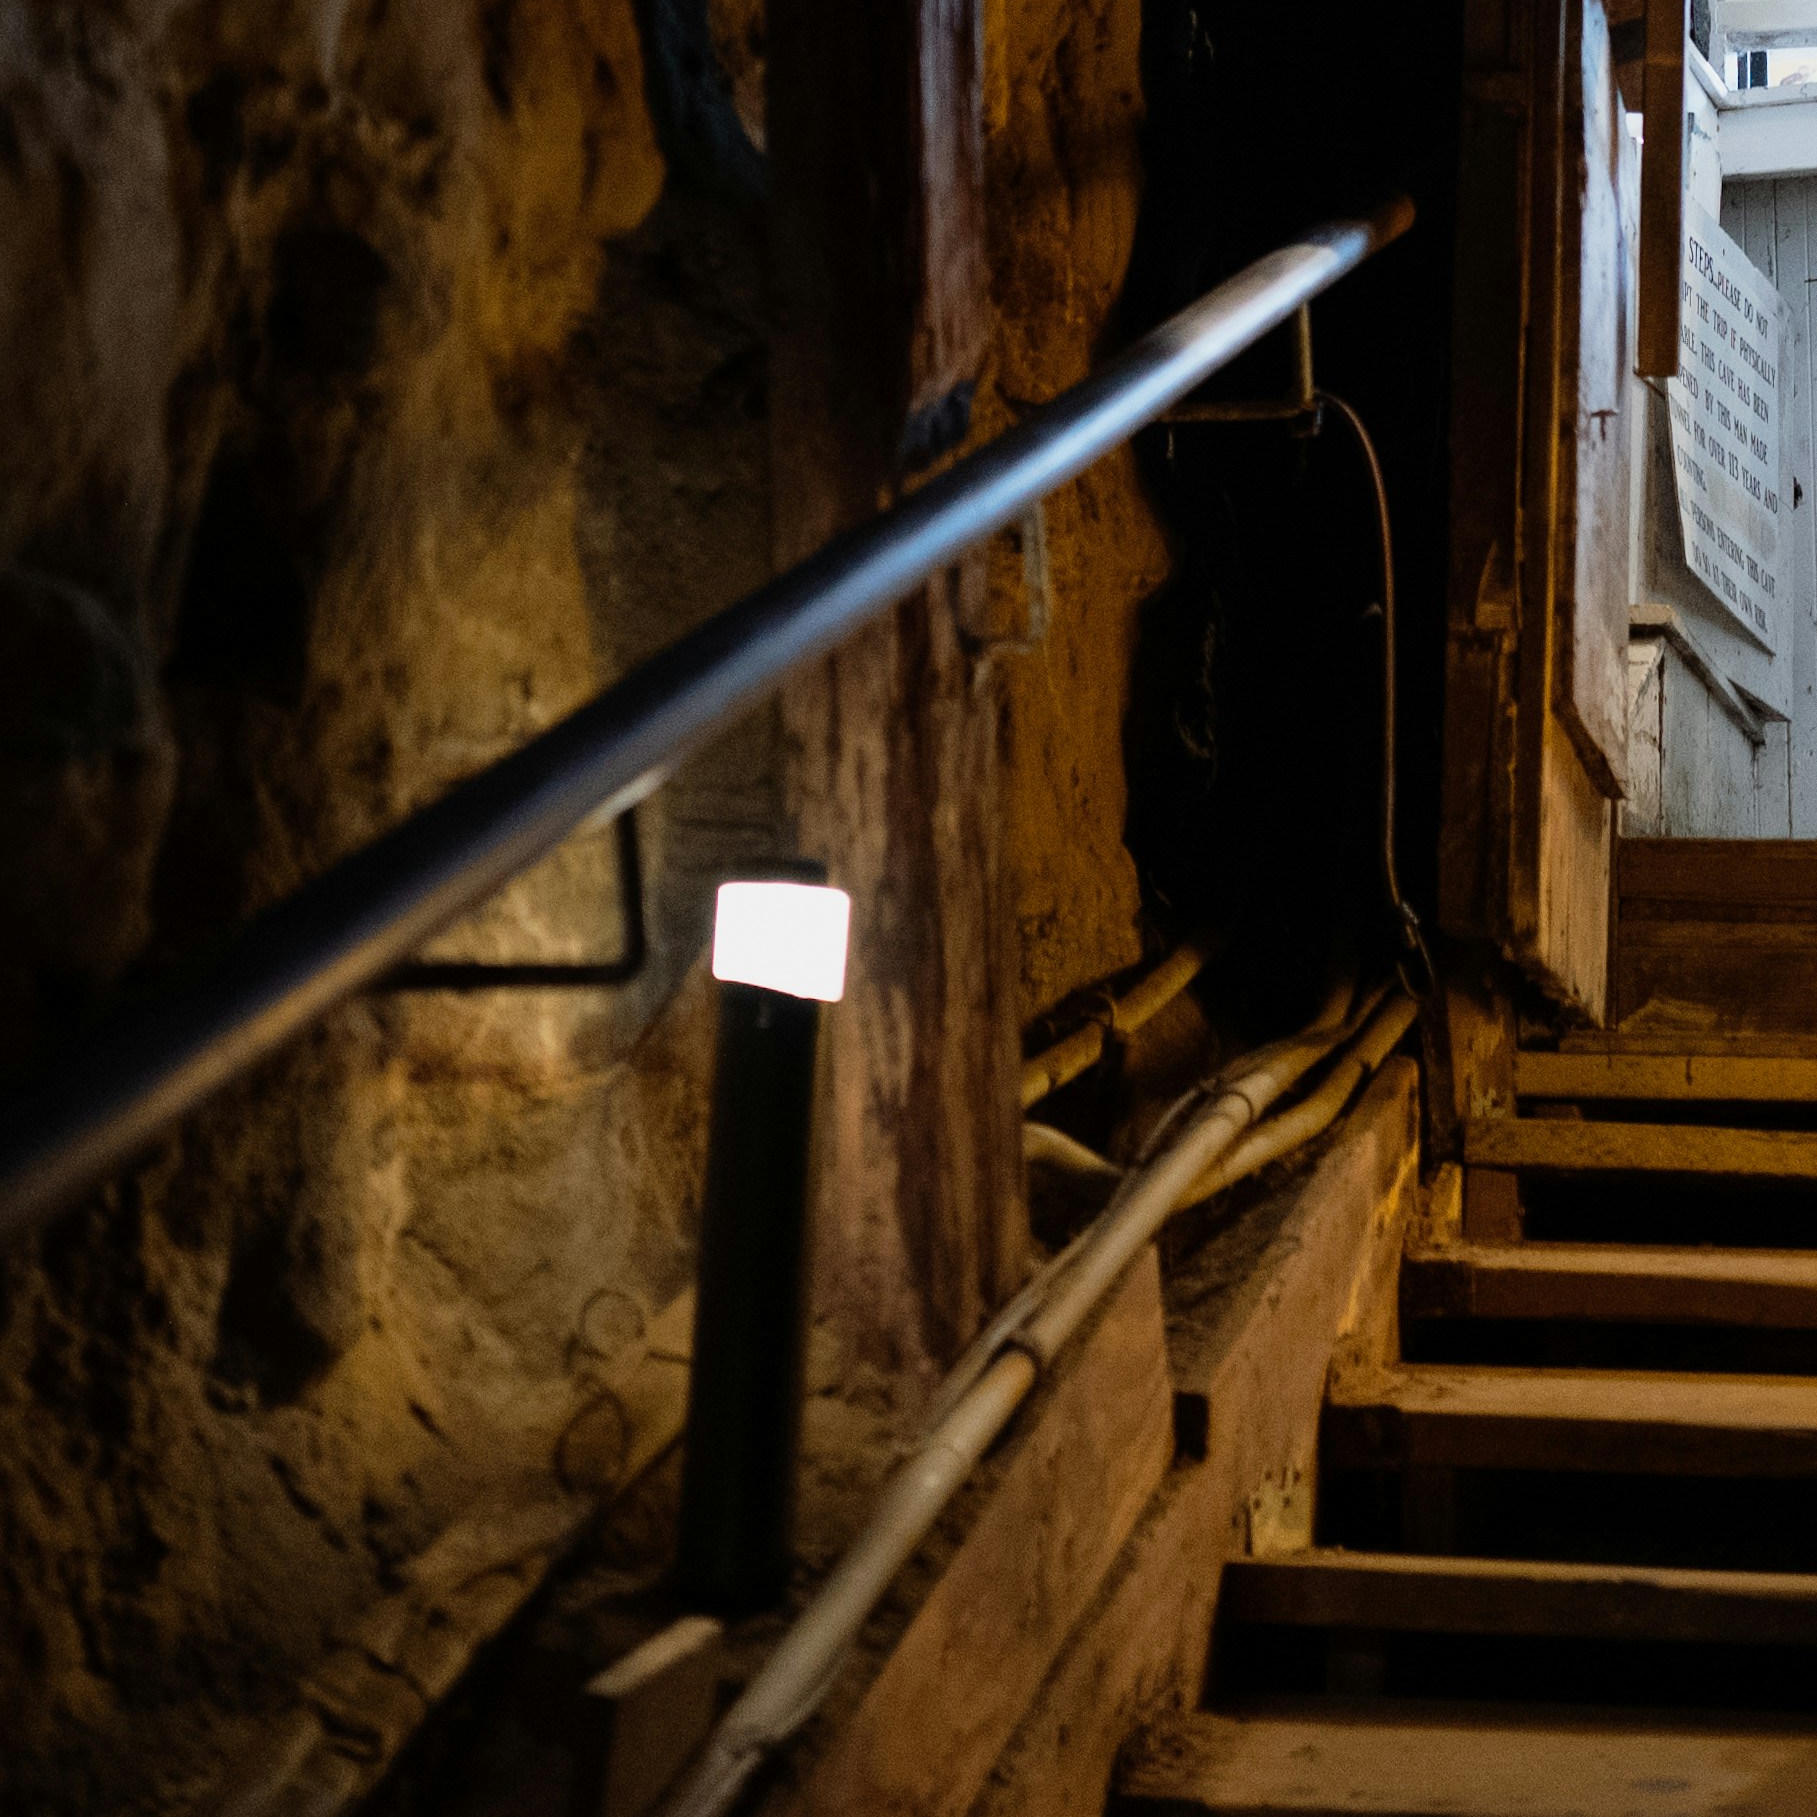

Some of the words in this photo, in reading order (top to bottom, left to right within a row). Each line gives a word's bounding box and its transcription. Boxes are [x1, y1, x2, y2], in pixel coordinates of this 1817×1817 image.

[1696, 293, 1709, 323] THE
[1713, 309, 1728, 341] TRIP
[1730, 327, 1736, 350] IF
[1739, 337, 1776, 388] PHYSICALLY
[1744, 298, 1754, 323] DO
[1756, 311, 1768, 339] NOT
[1701, 341, 1715, 373] THIS
[1718, 359, 1735, 392] CAVE
[1737, 378, 1750, 407] HAS
[1753, 392, 1769, 424] BEEN
[1705, 389, 1713, 414] BY
[1717, 401, 1731, 431] THIS
[1733, 416, 1748, 446] MAN
[1750, 434, 1768, 465] MADE
[1693, 420, 1706, 450] FOR
[1708, 436, 1725, 470] OVER
[1728, 451, 1739, 480] 113
[1741, 465, 1761, 501] YEARS
[1764, 487, 1778, 514] AND
[1746, 554, 1759, 584] THIS
[1760, 569, 1775, 599] CAVE
